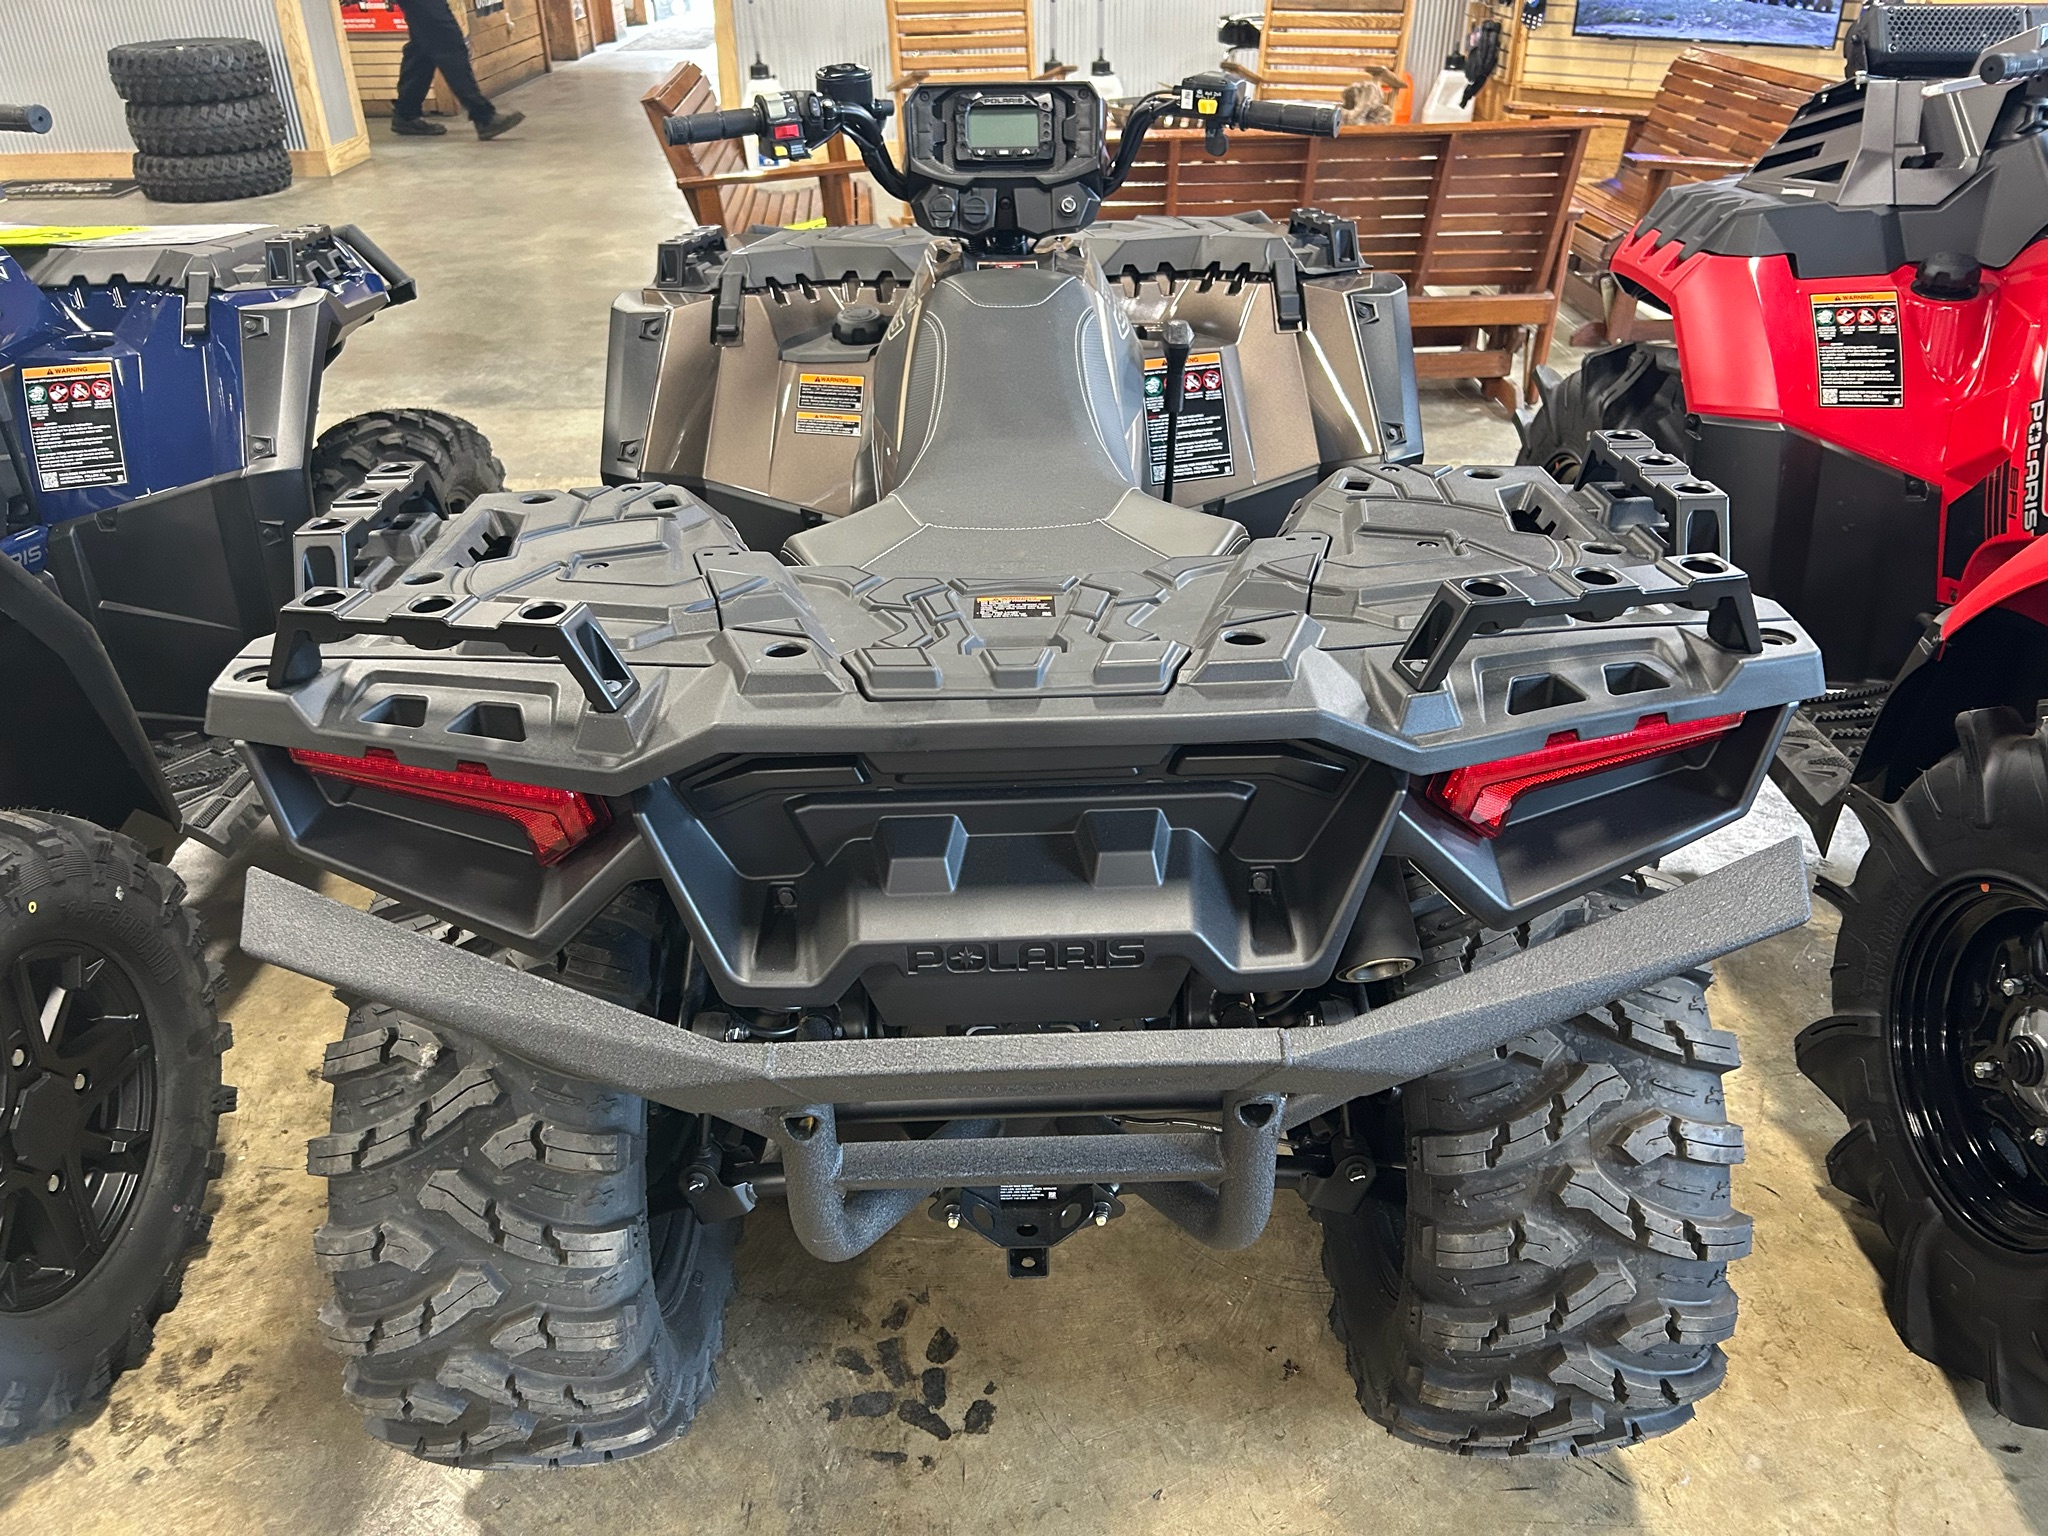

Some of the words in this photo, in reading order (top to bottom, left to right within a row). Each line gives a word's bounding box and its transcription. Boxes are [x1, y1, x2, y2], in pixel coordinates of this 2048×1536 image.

[54, 366, 88, 375] WARNING
[2024, 400, 2045, 531] POLARIS
[906, 938, 1146, 975] POLARIS
